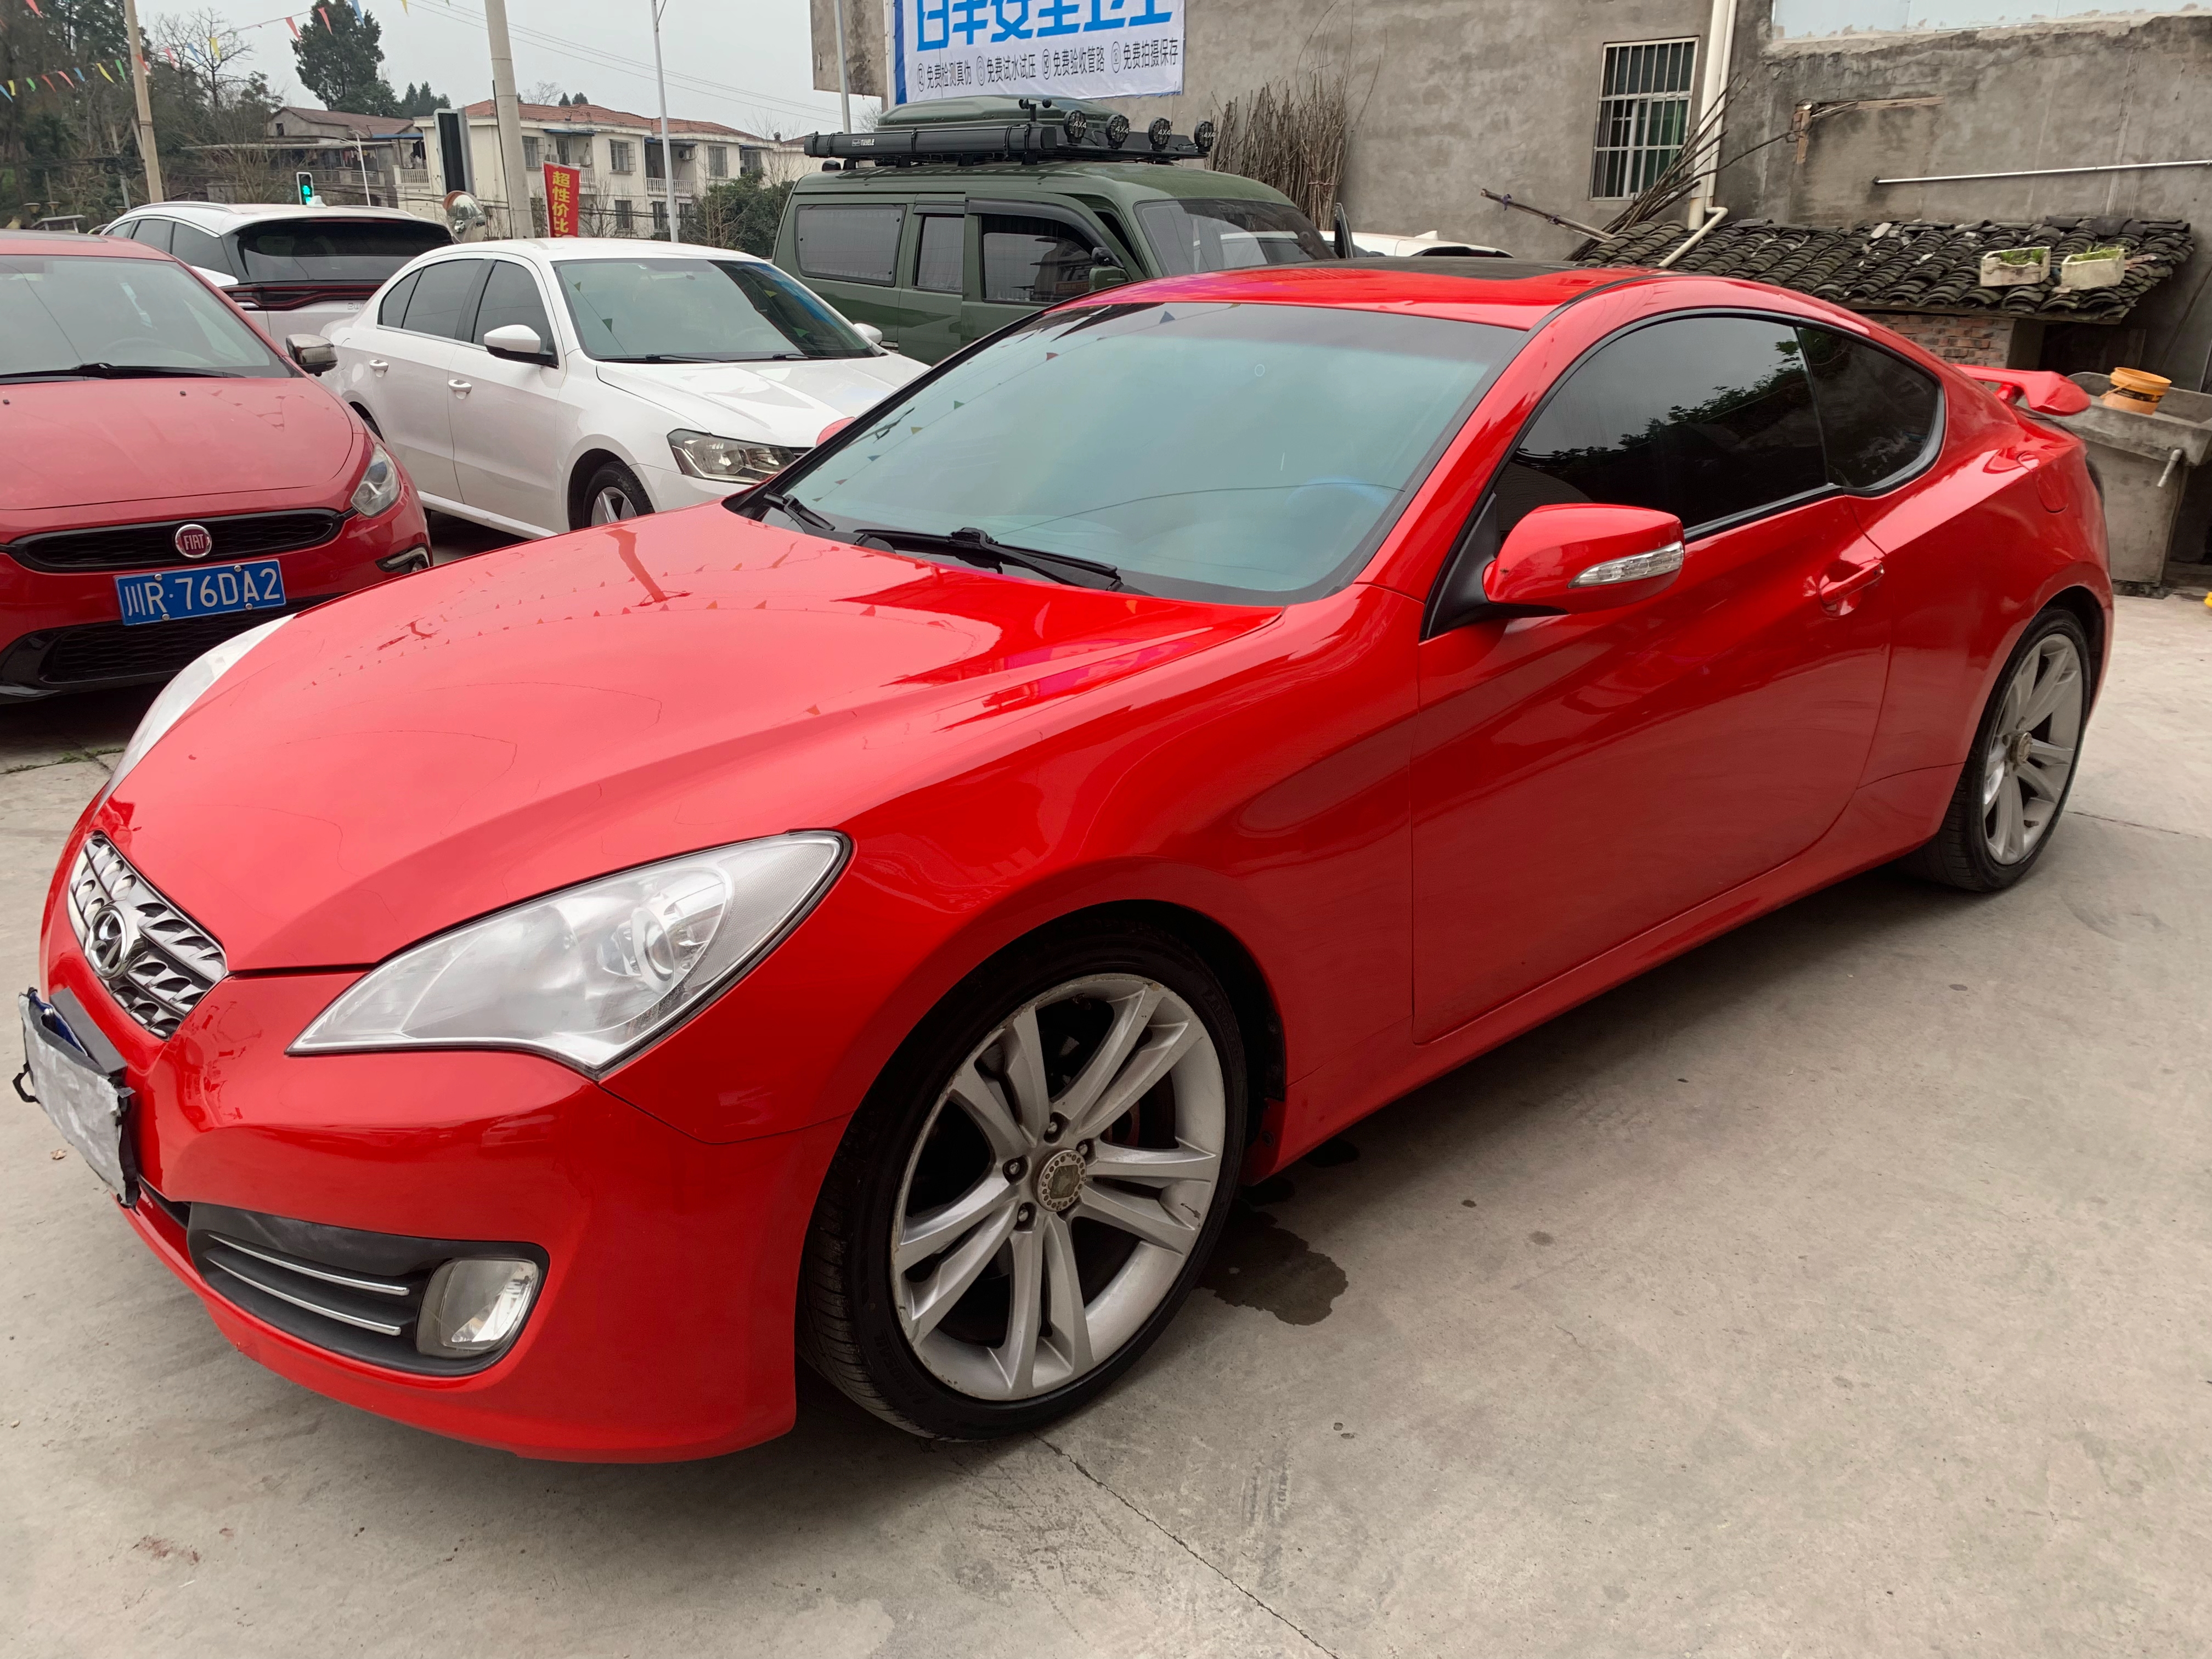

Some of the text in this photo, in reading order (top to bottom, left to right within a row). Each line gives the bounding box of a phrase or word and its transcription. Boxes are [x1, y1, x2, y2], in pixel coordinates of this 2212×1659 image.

[927, 37, 1178, 89] 免费检测真伪 免费试水试压 免费验收管路 免费拍摄保存
[552, 171, 570, 236] 超性价比
[184, 534, 204, 550] FIAT
